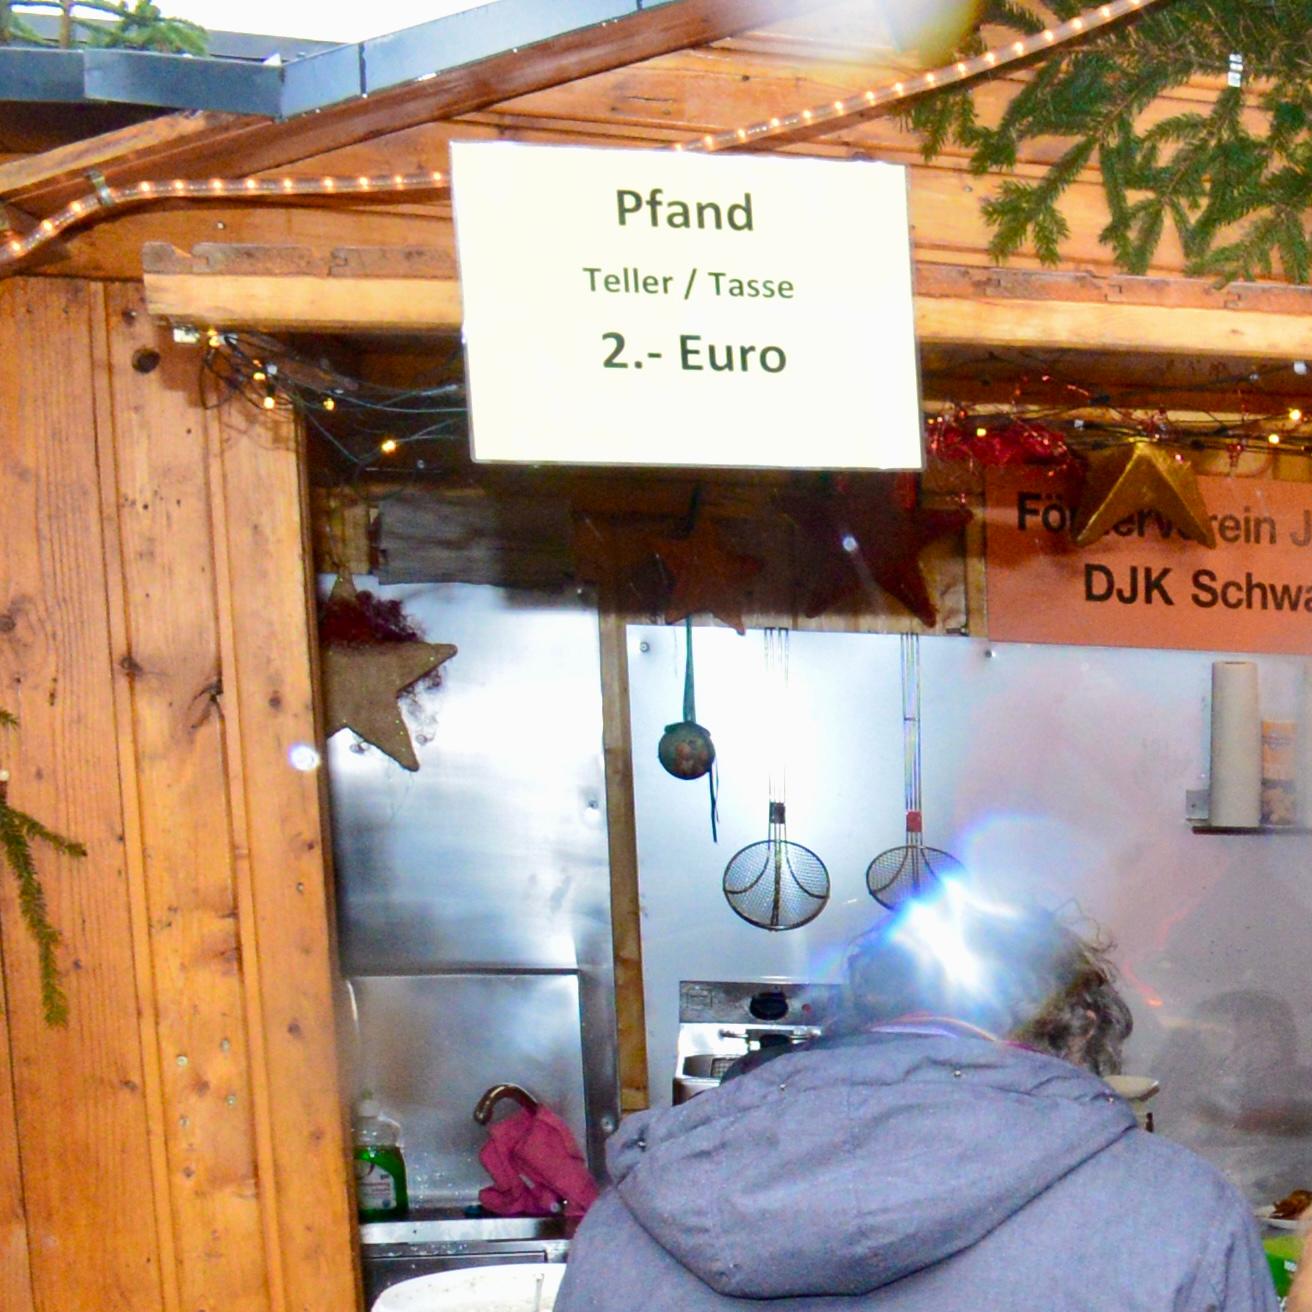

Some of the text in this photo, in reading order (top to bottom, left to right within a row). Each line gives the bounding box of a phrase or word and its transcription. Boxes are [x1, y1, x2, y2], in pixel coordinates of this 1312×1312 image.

[617, 188, 754, 232] Pfand
[584, 268, 794, 300] Teller / Tasse
[602, 332, 787, 374] 2.- Euro
[1083, 563, 1176, 607] DJK
